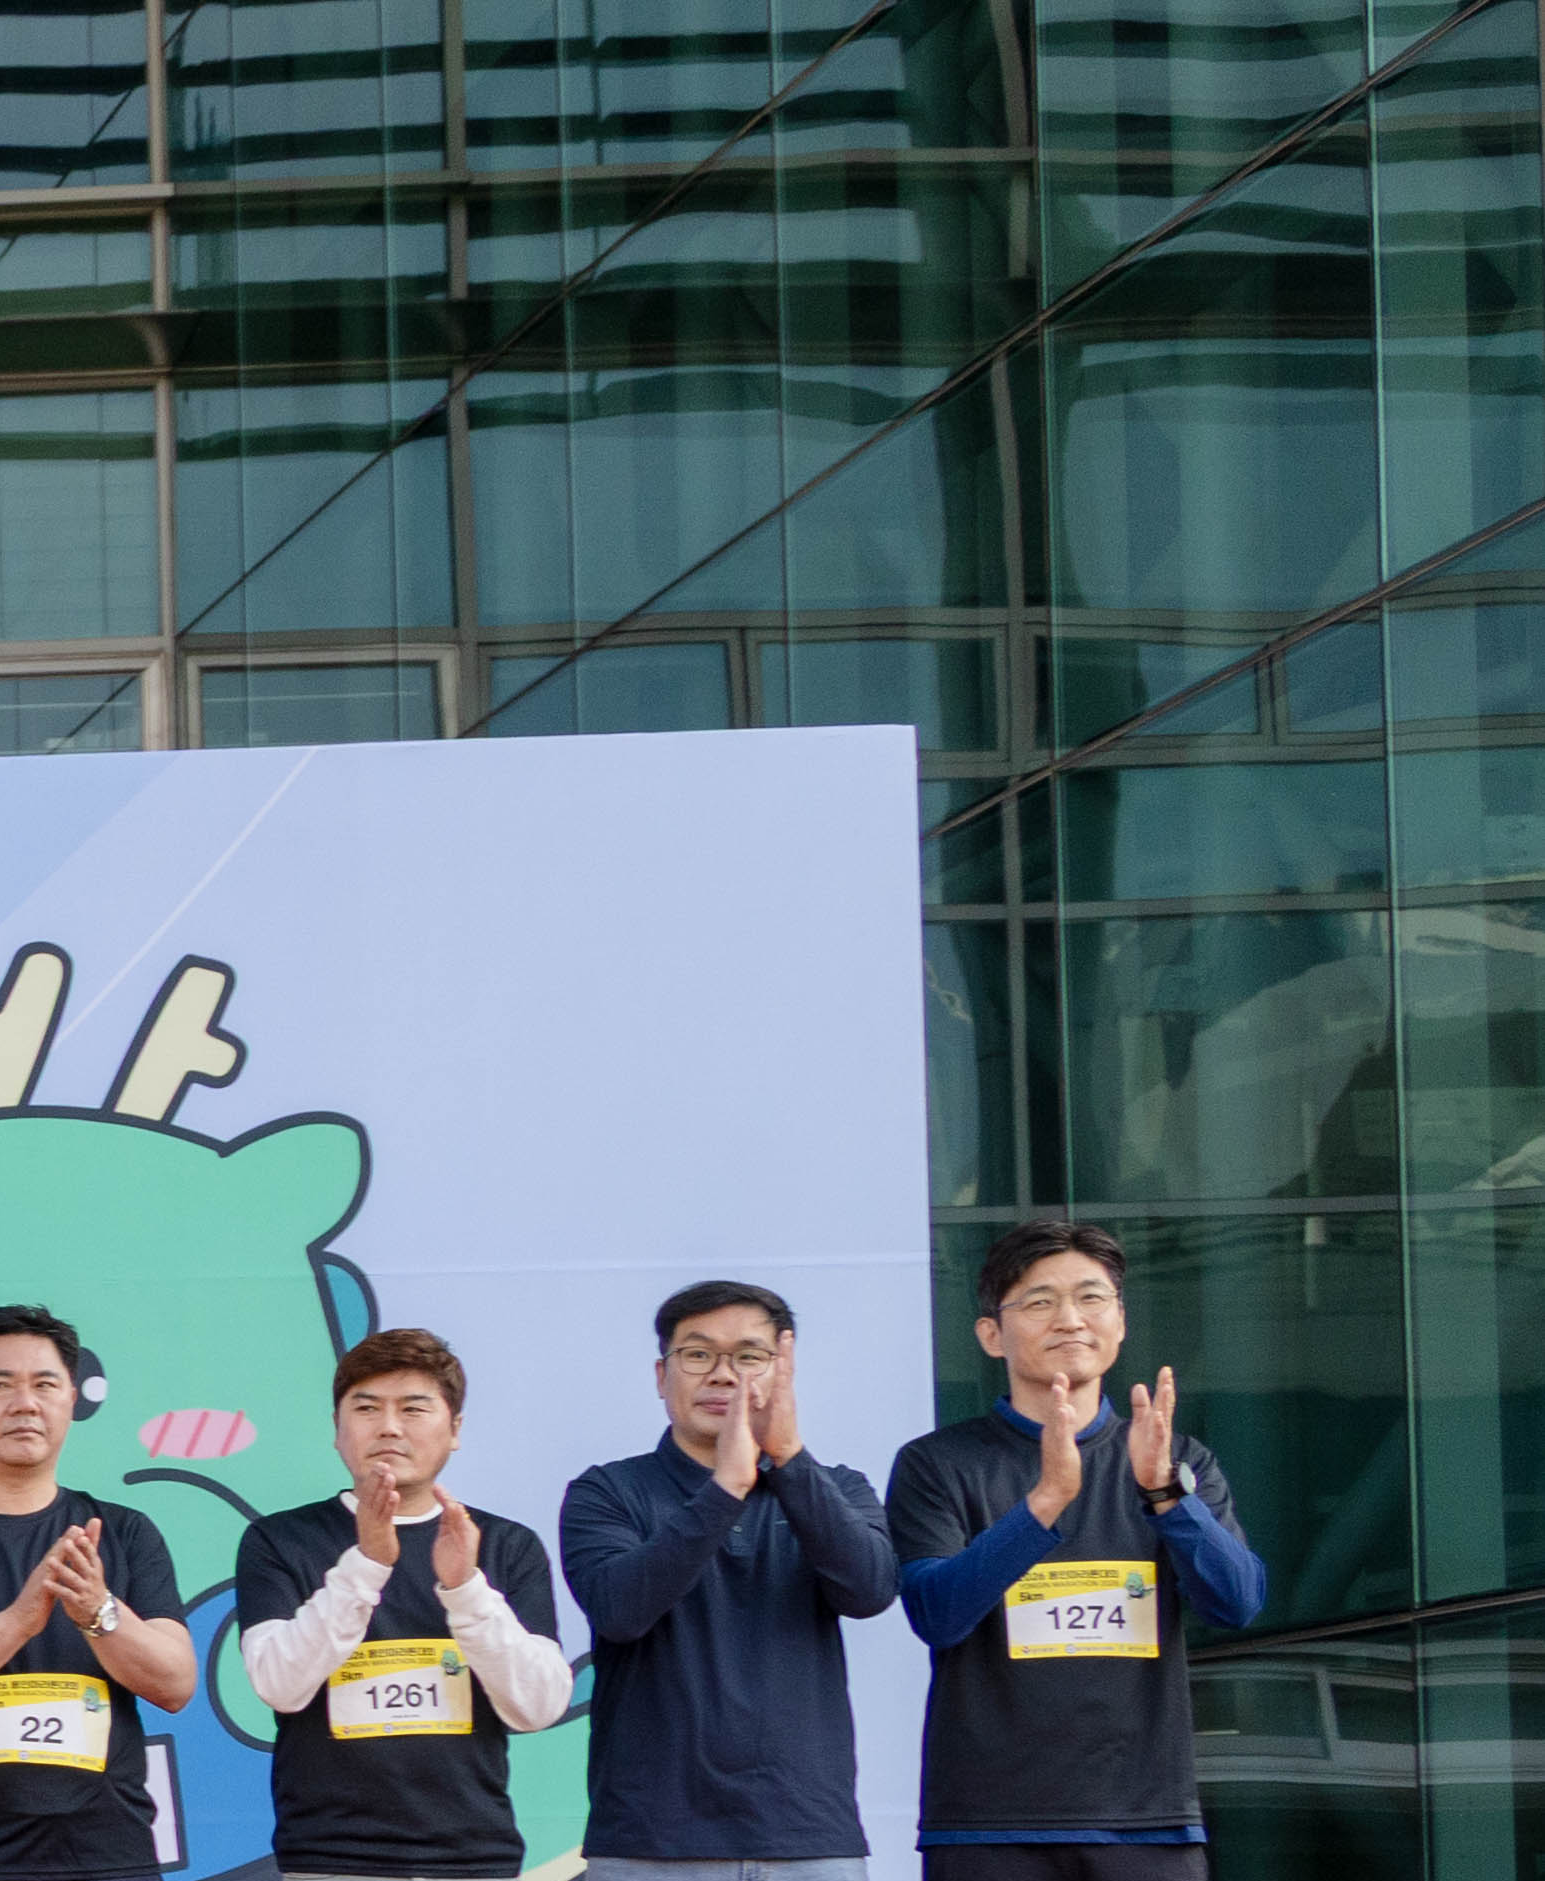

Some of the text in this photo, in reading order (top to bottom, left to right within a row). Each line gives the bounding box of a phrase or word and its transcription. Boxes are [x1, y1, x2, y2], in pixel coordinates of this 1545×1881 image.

[1046, 1605, 1127, 1631] 1274
[365, 1683, 439, 1710] 1261
[20, 1716, 64, 1744] 22
